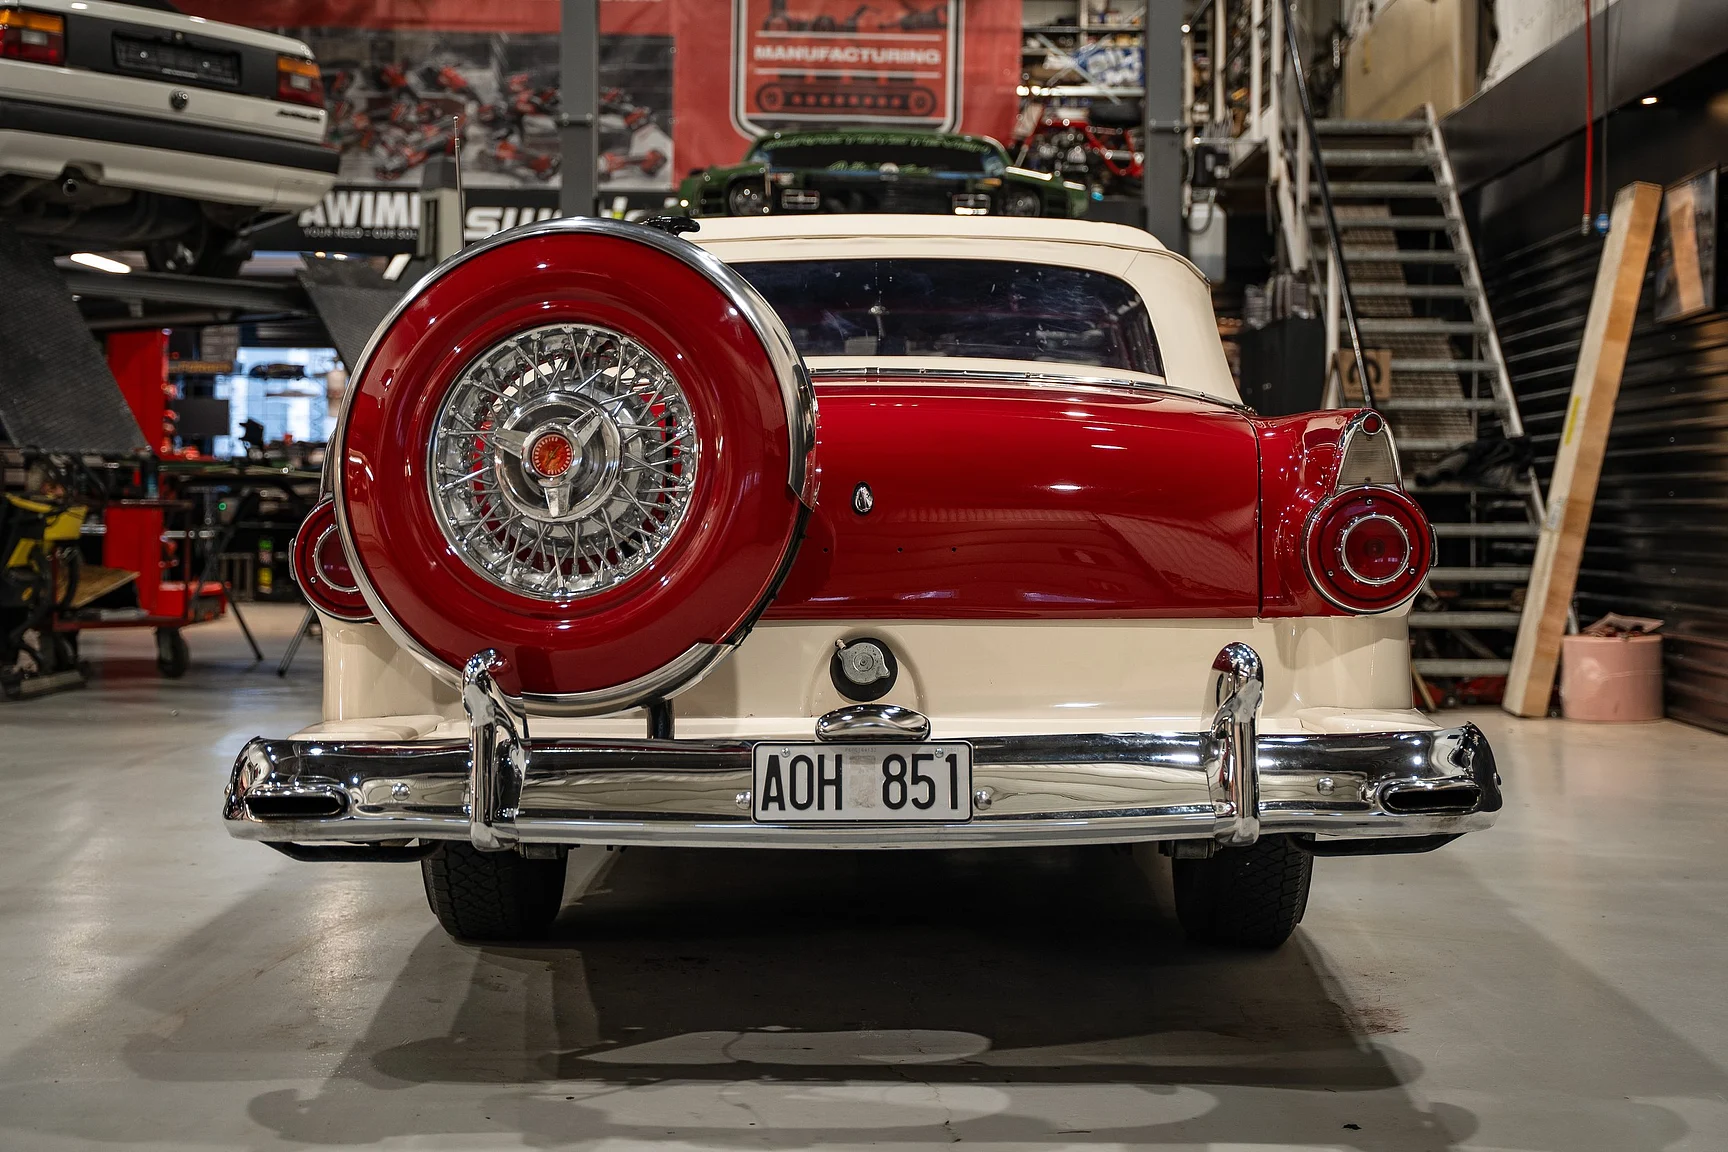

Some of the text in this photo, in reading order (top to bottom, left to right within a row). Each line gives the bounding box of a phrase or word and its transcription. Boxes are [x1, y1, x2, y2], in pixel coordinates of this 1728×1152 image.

[753, 46, 942, 66] MANUFACTURING
[761, 753, 958, 810] AOH 851
